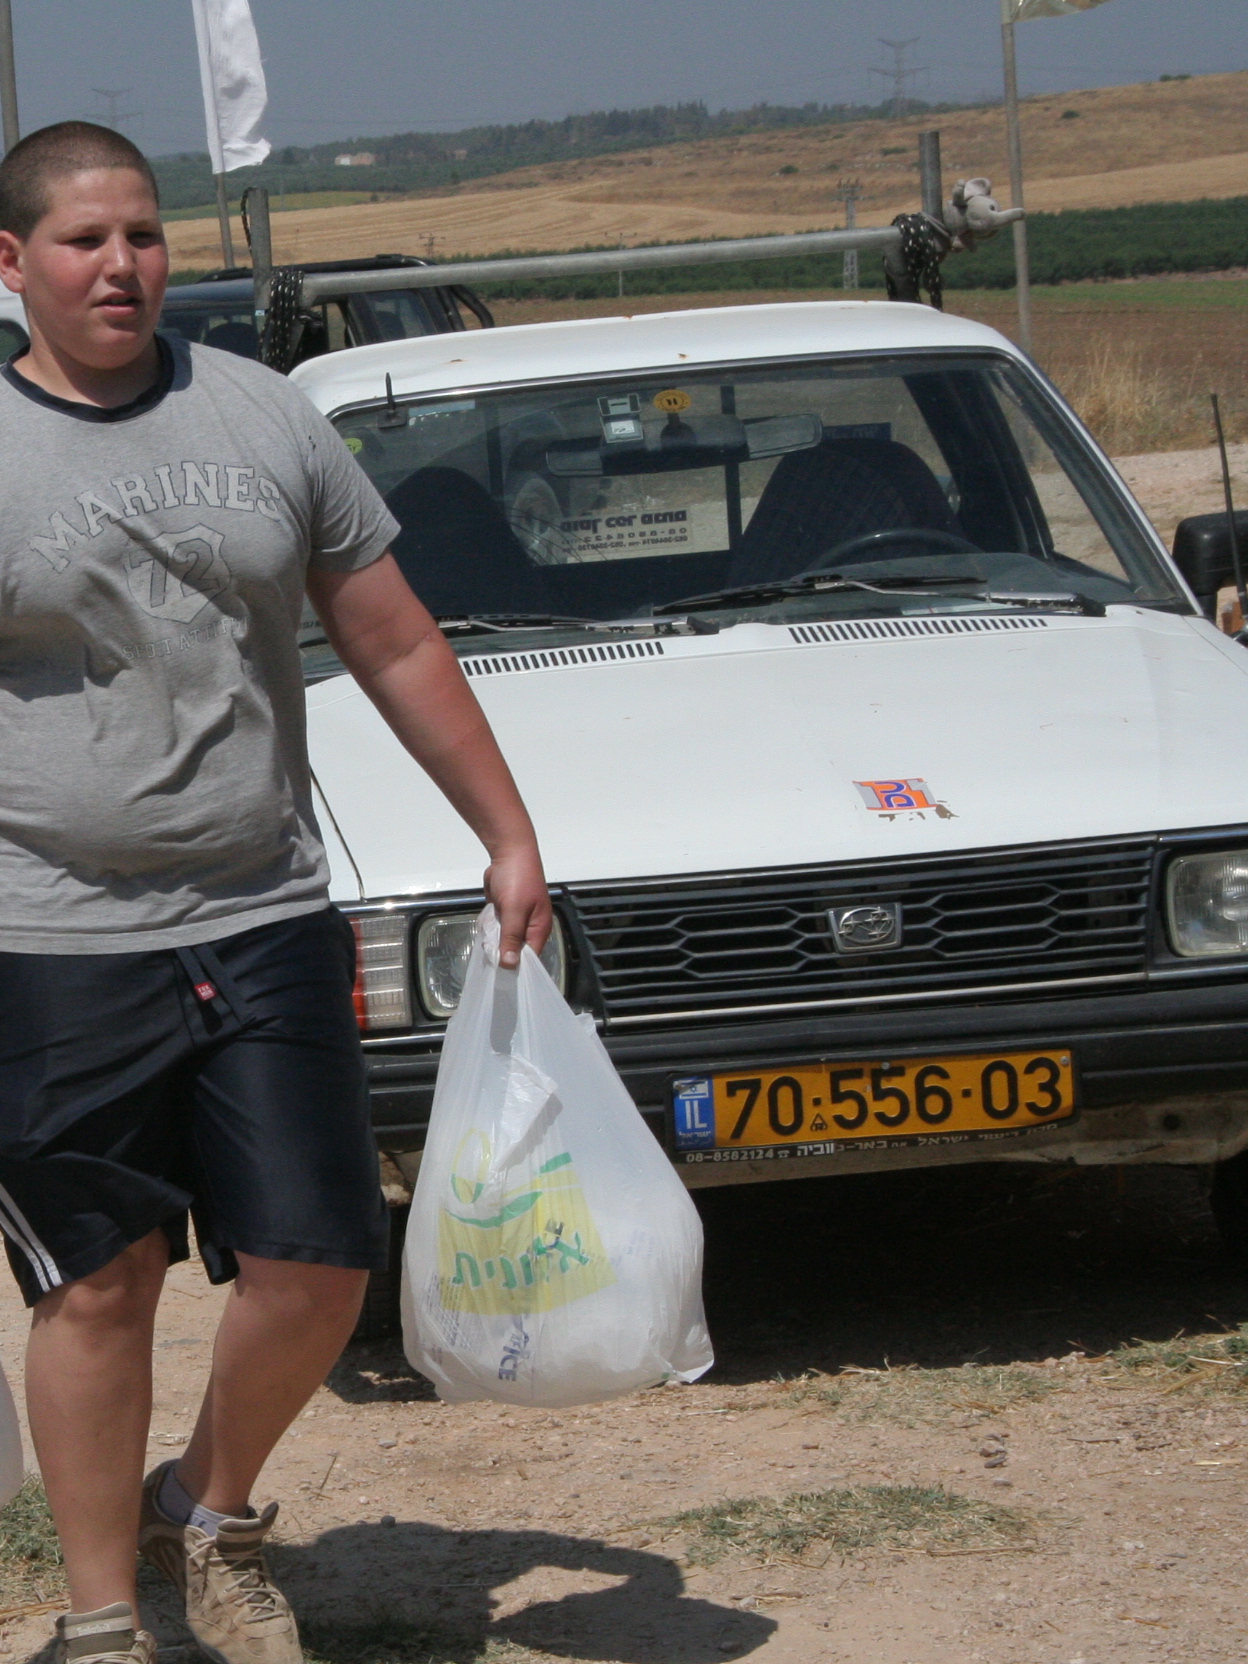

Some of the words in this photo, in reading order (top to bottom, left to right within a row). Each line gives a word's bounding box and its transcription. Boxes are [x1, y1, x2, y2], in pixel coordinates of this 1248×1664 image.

[28, 460, 282, 574] MARINES
[131, 537, 222, 609] 72
[121, 637, 172, 661] SPOT
[685, 1100, 708, 1129] IL
[686, 1148, 774, 1164] 08-8582124
